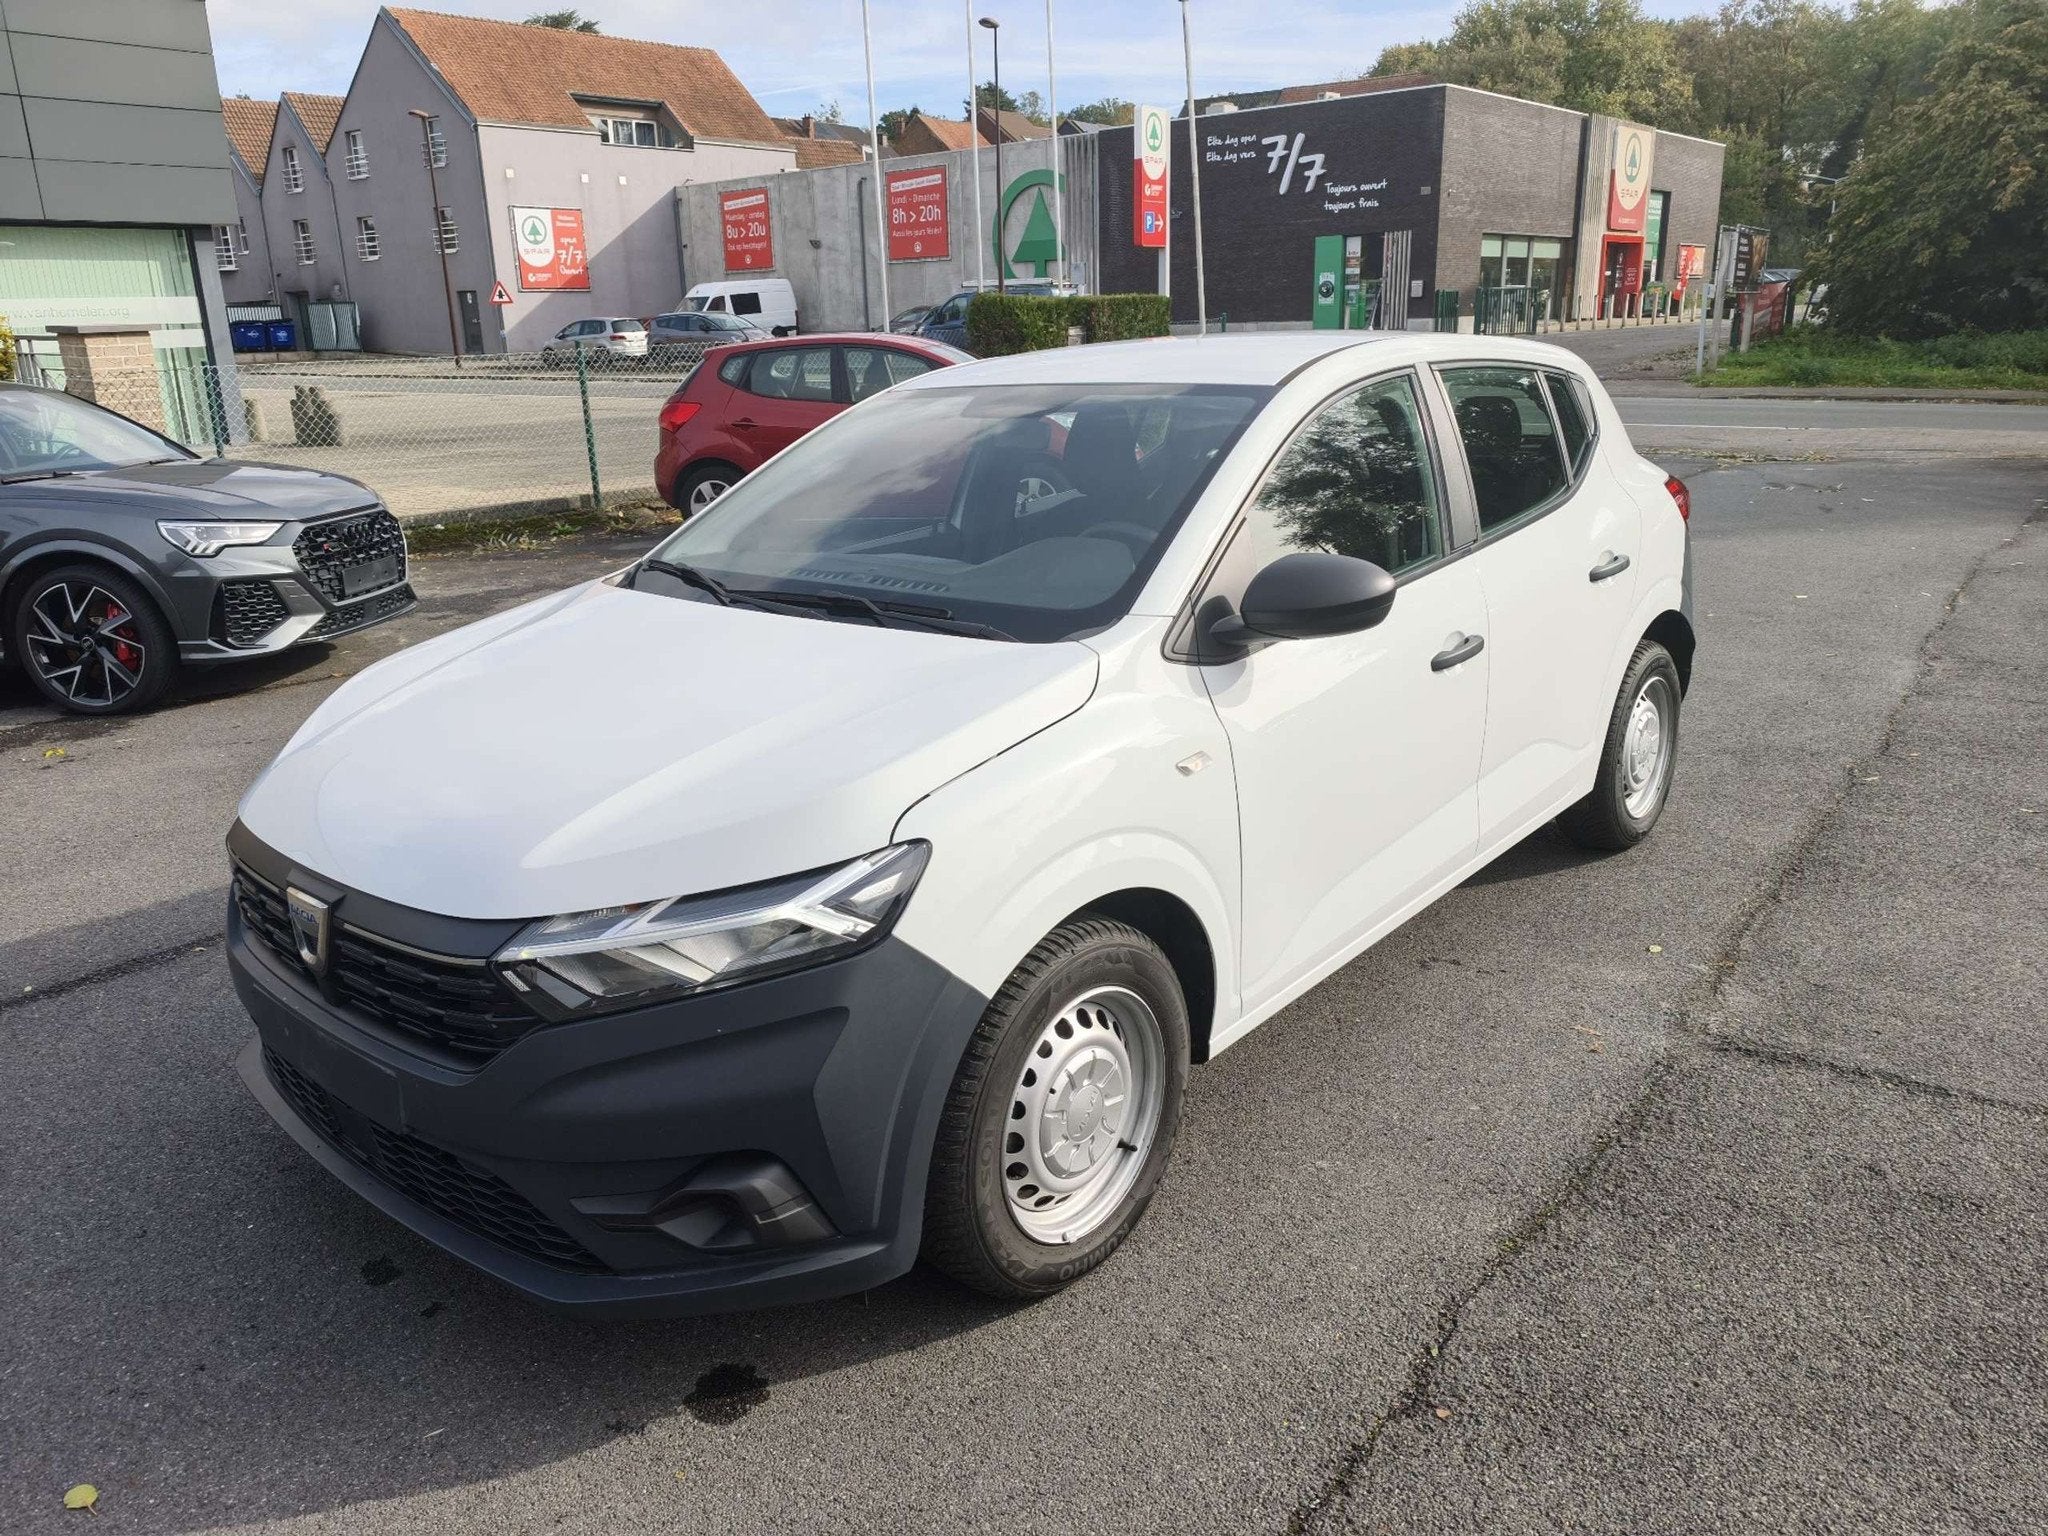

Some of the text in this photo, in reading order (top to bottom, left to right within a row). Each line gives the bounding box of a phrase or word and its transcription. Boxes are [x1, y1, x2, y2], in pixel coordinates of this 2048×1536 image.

[1207, 134, 1257, 147] Elke dag open
[1145, 155, 1164, 165] SPAR
[1206, 150, 1257, 163] Elke dag vers
[1261, 132, 1327, 195] 7/7
[1360, 178, 1388, 191] ouvert
[1359, 197, 1380, 208] frais
[892, 208, 907, 224] 8h
[919, 205, 942, 222] 20h
[726, 224, 739, 239] 8u
[748, 221, 766, 237] 20u
[523, 247, 551, 255] SPAR
[557, 246, 583, 265] 7/7
